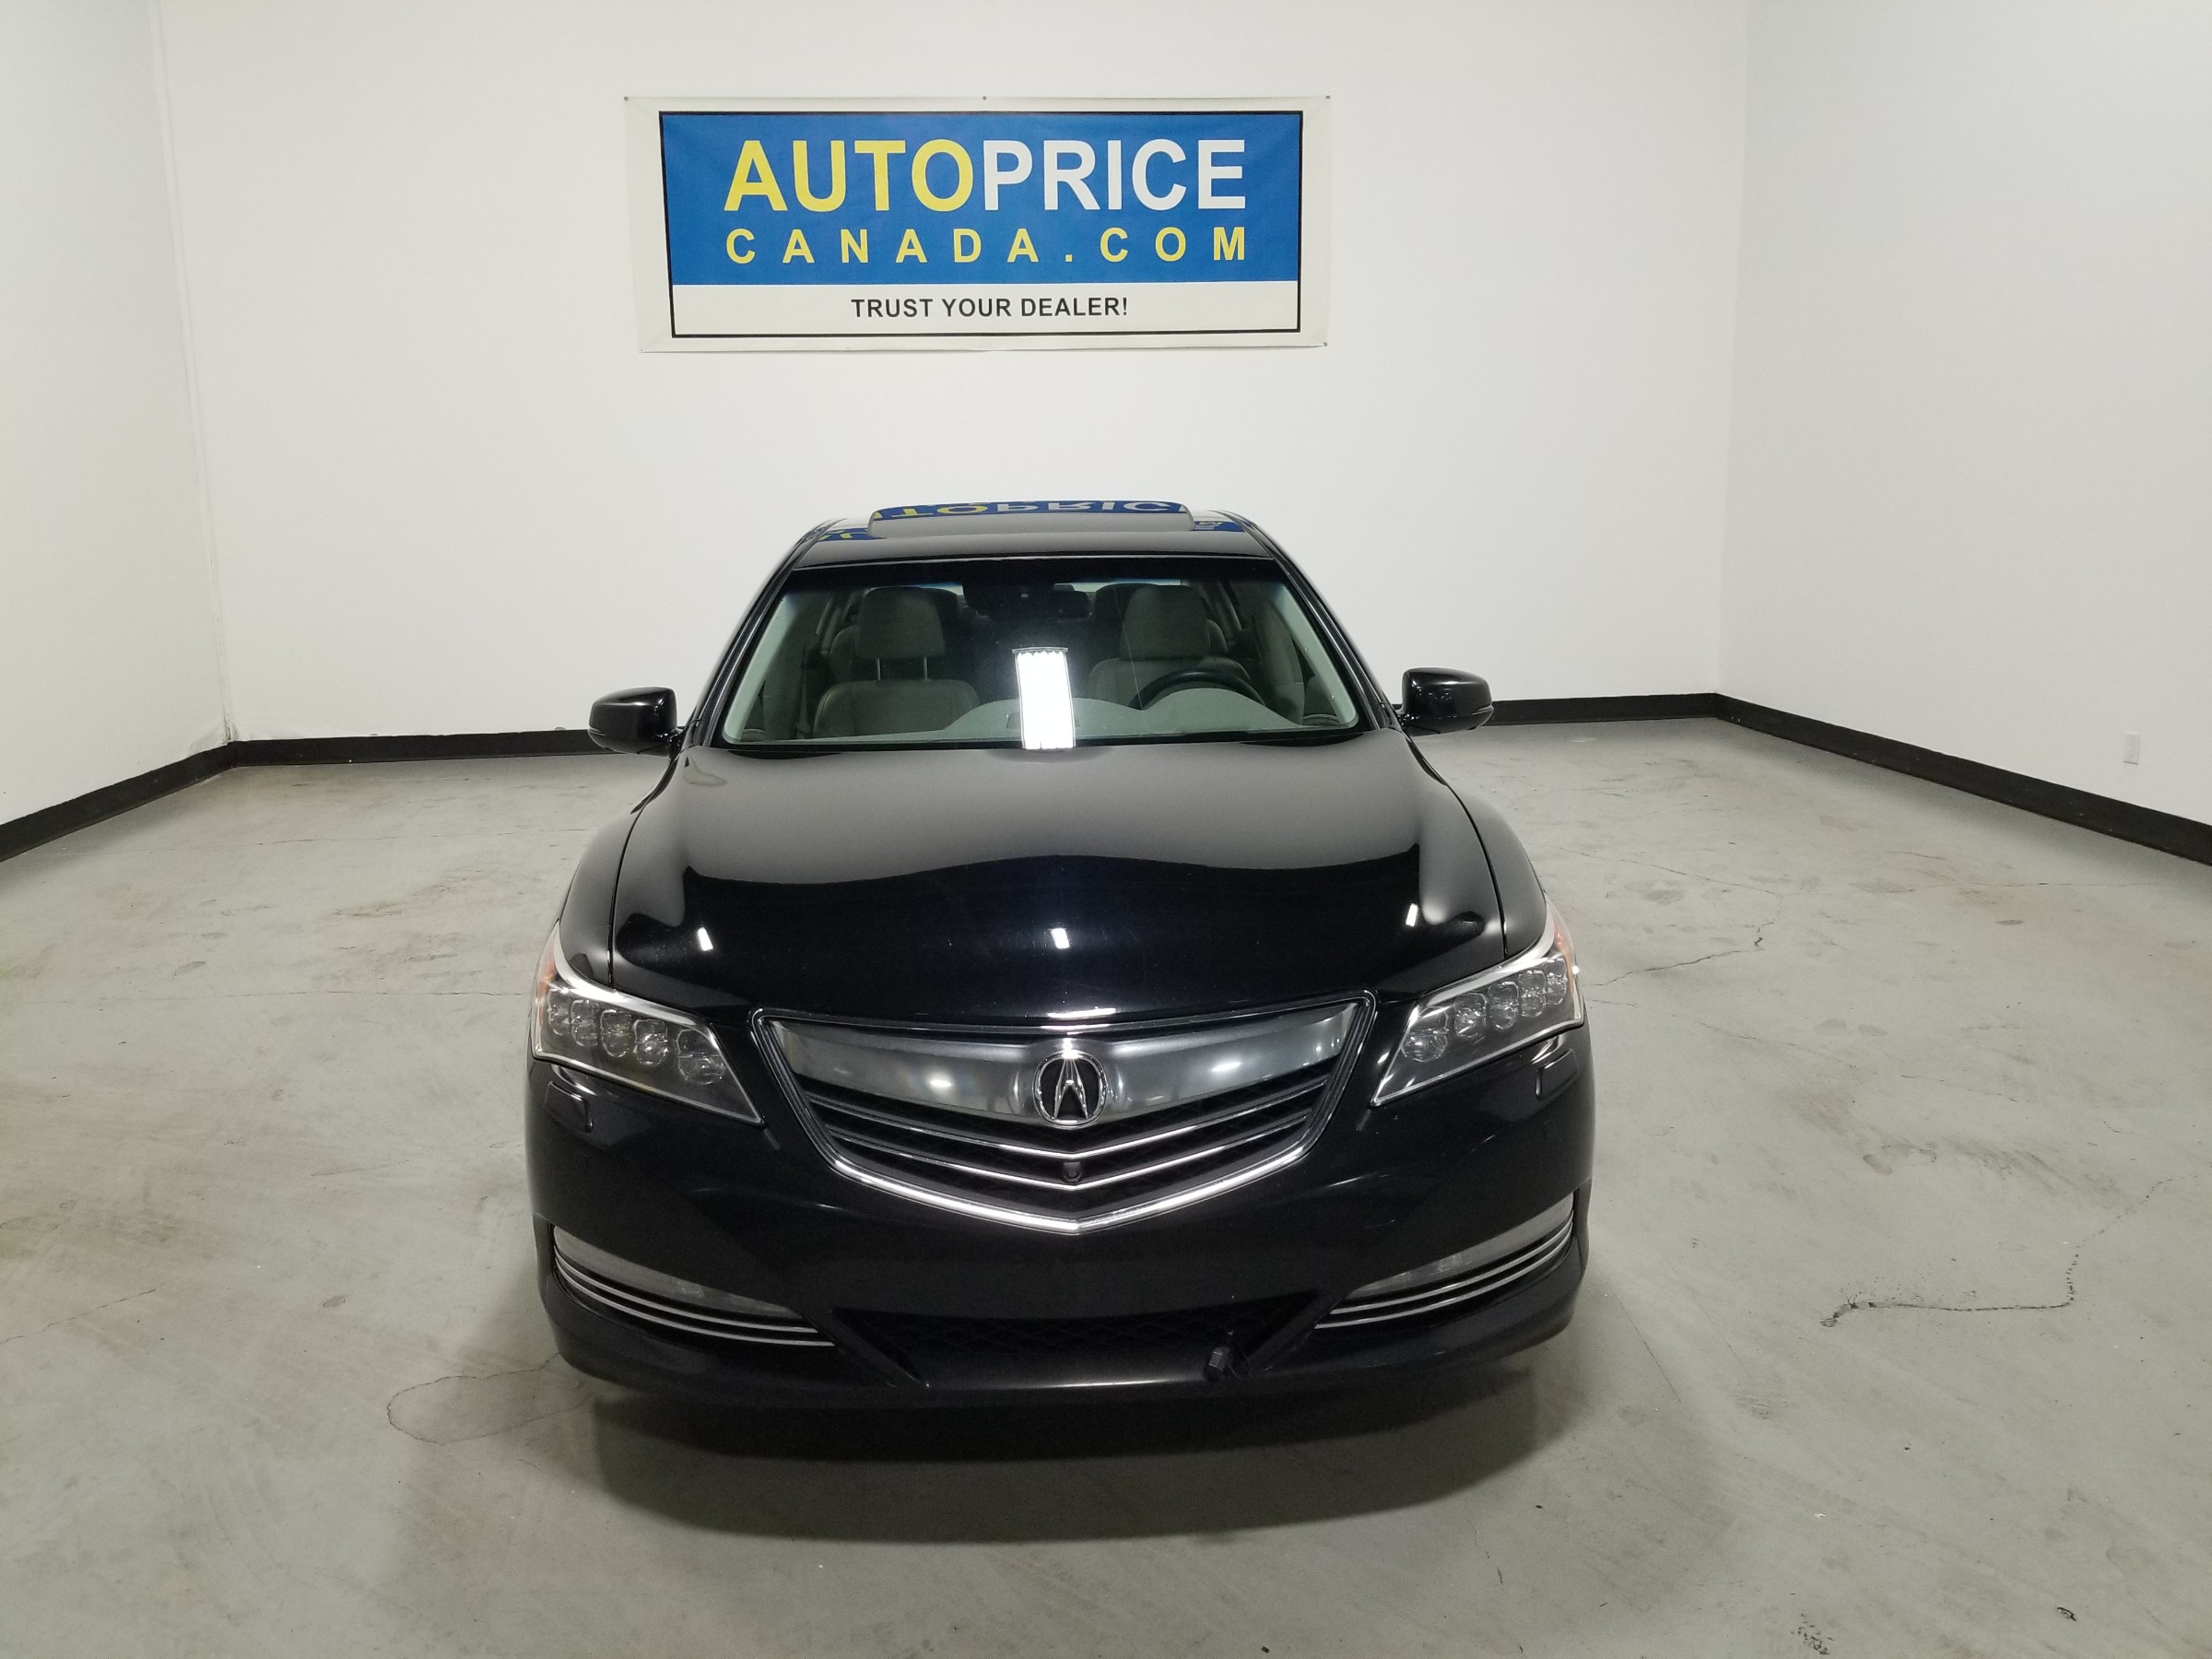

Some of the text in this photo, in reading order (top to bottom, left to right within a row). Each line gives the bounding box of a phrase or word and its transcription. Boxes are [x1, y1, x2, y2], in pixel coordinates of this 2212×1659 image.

[724, 138, 1247, 213] AUTOPRICE
[725, 227, 1246, 265] CANADA.COM
[851, 298, 1128, 319] TRUST YOUR DEALER!
